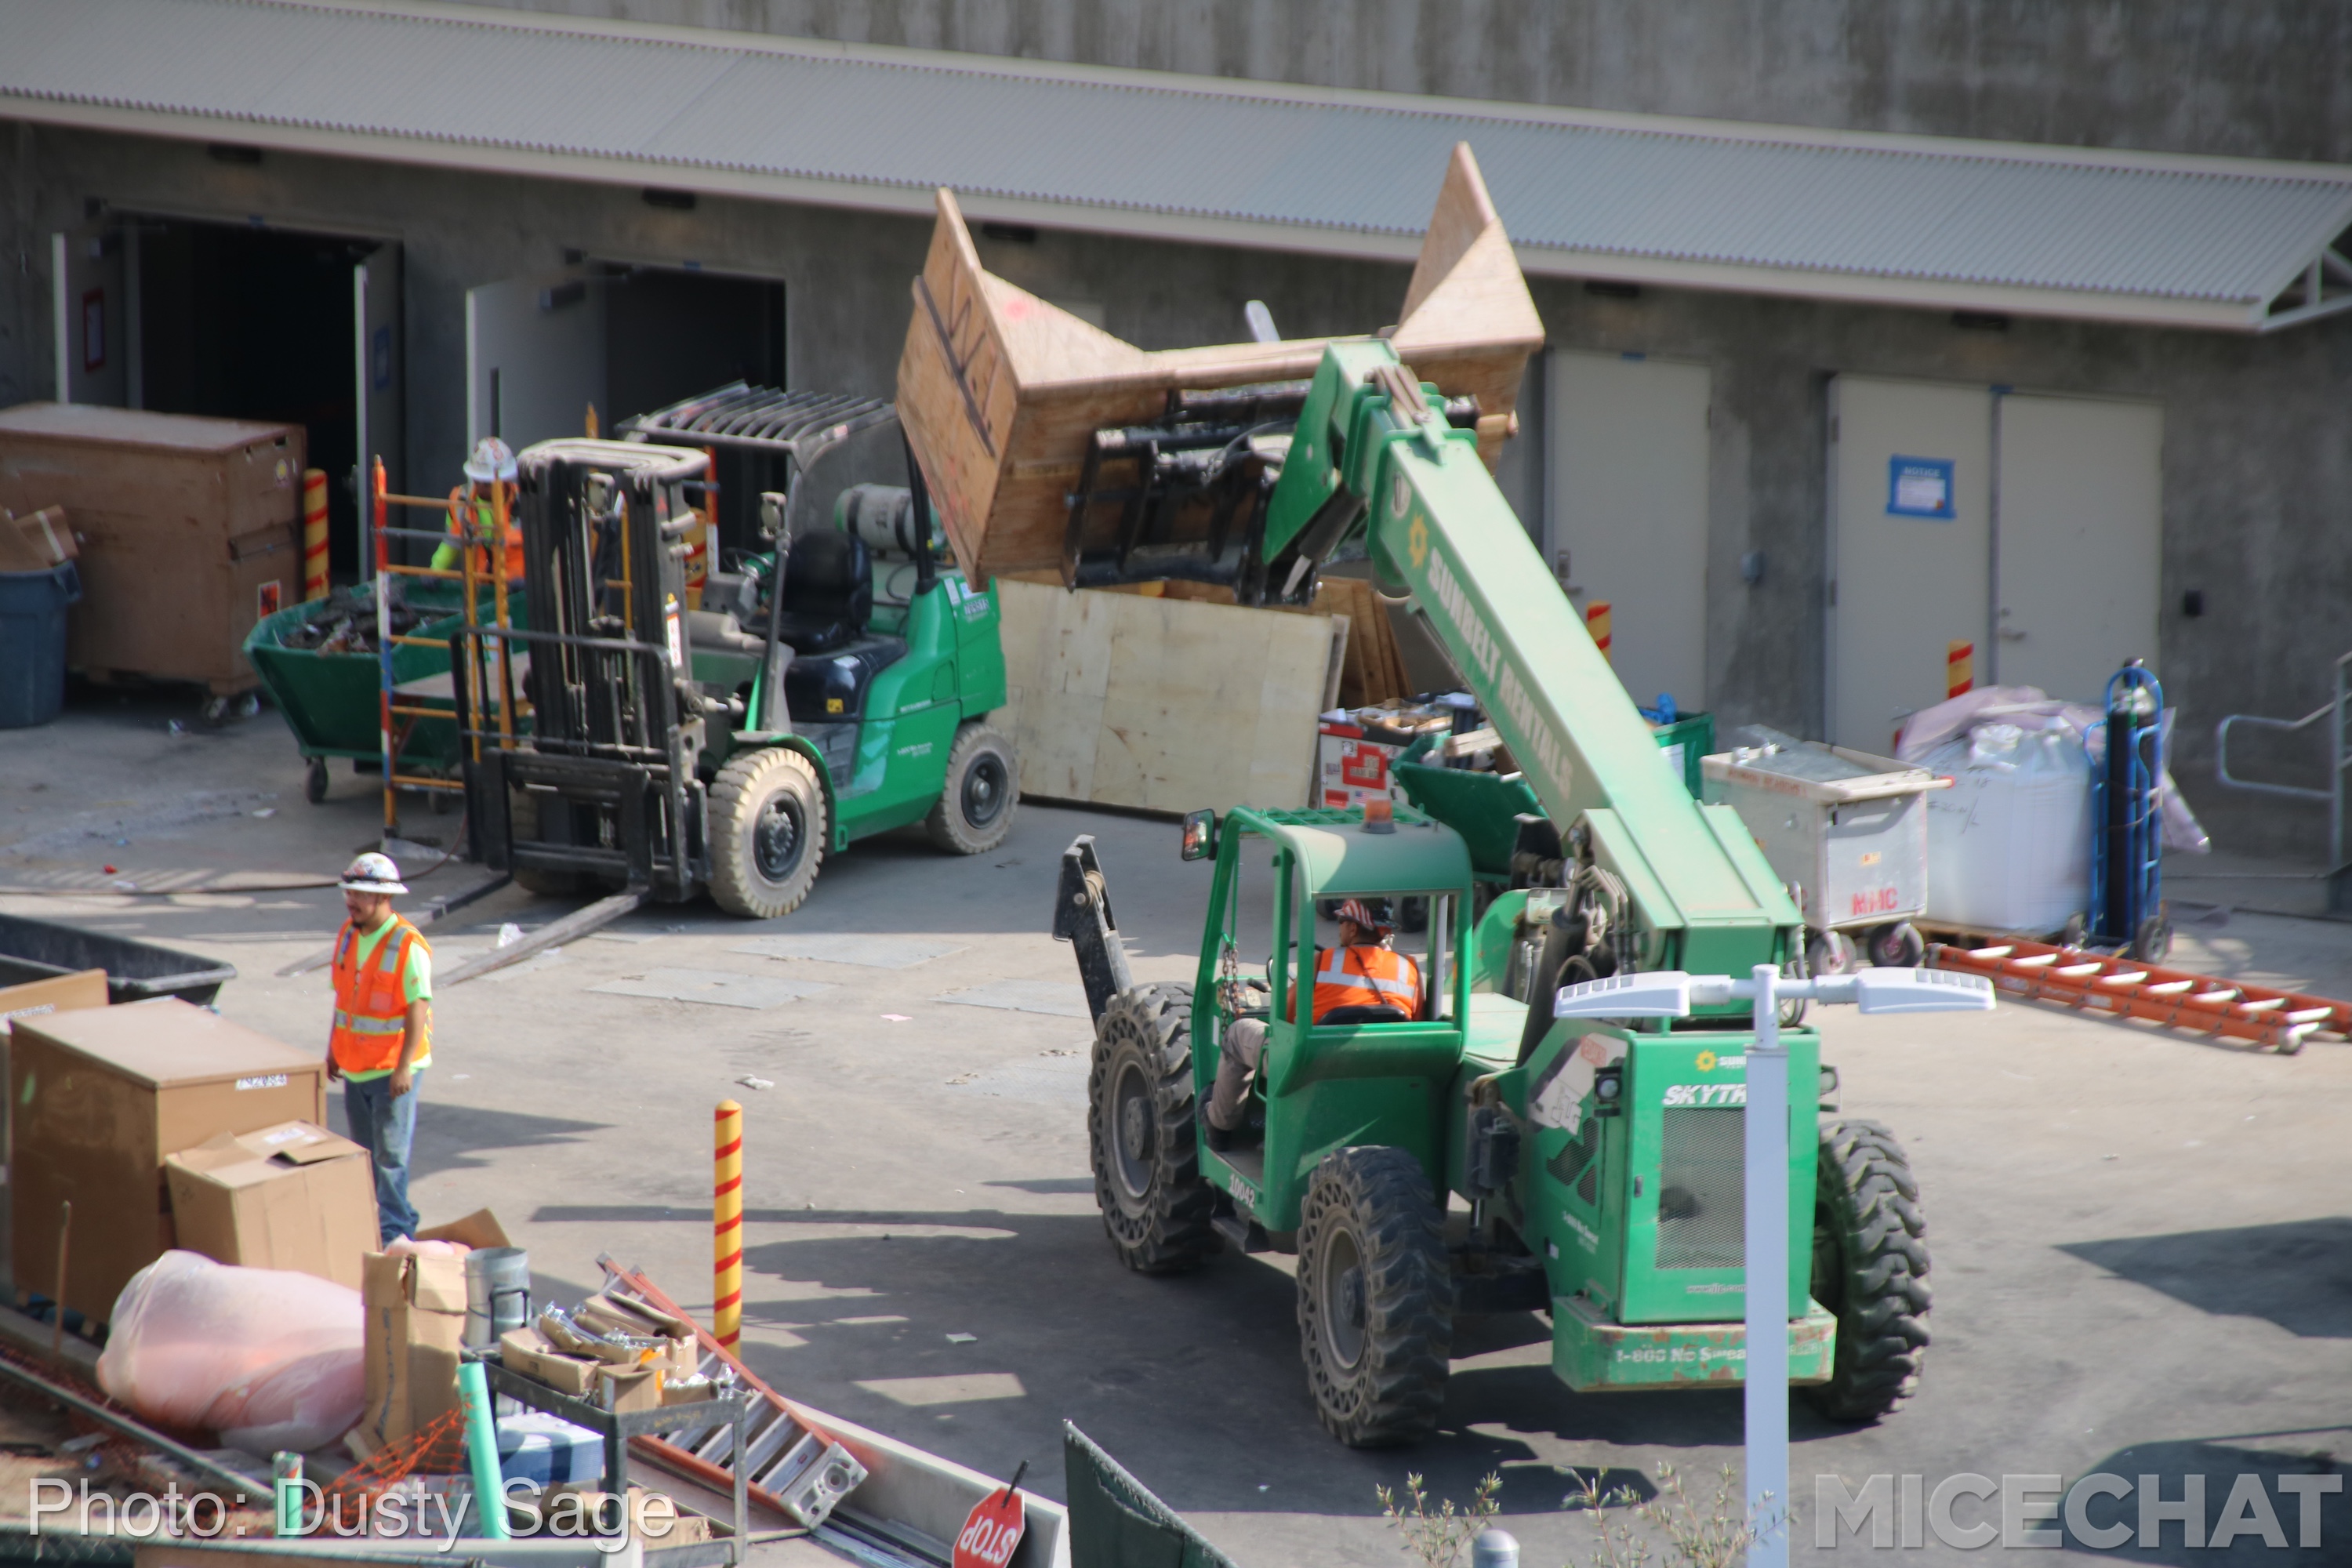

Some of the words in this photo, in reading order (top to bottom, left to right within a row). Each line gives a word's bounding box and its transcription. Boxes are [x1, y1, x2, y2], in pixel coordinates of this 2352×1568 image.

[1904, 466, 1940, 477] NOTICE
[1428, 546, 1501, 685] SUNBELT
[1498, 659, 1573, 800] RENTALS
[1718, 1055, 1747, 1065] SUN
[1661, 1083, 1748, 1105] SKYTR
[1228, 1173, 1255, 1209] 10042
[1616, 1348, 1667, 1363] 1-800
[1670, 1348, 1697, 1362] No
[1699, 1346, 1747, 1361] Swea
[960, 1514, 1018, 1564] STOP
